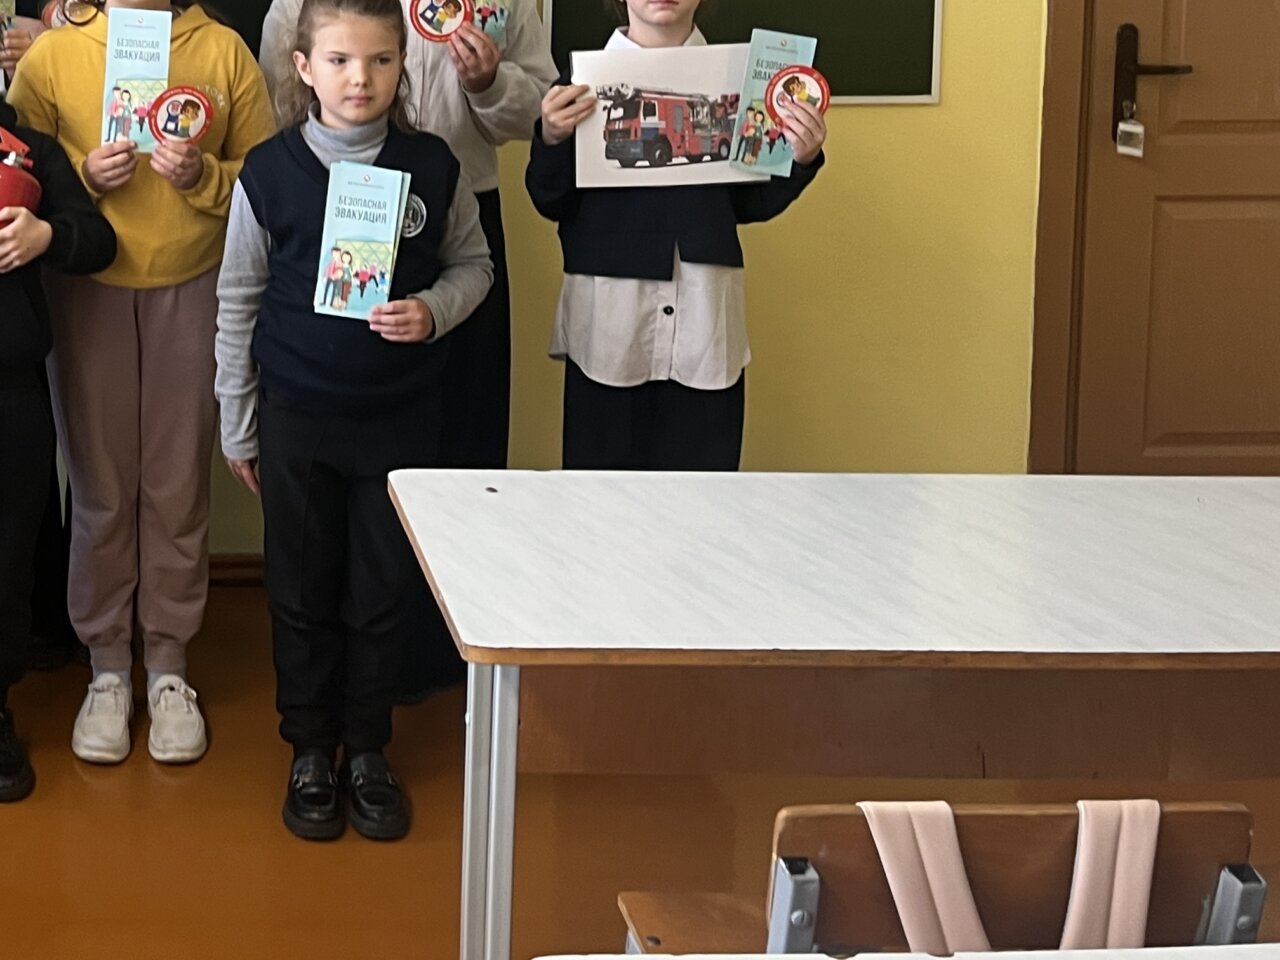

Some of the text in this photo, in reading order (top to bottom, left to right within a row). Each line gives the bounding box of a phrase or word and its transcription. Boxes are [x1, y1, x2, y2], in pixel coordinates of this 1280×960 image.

[117, 38, 160, 49] БЕЗОПАСНАЯ
[113, 49, 161, 62] ЭВАКУАЦИЯ
[338, 195, 387, 210] БЕЗОПАСНАЯ
[335, 206, 387, 224] ЭВАКУАЦИЯ
